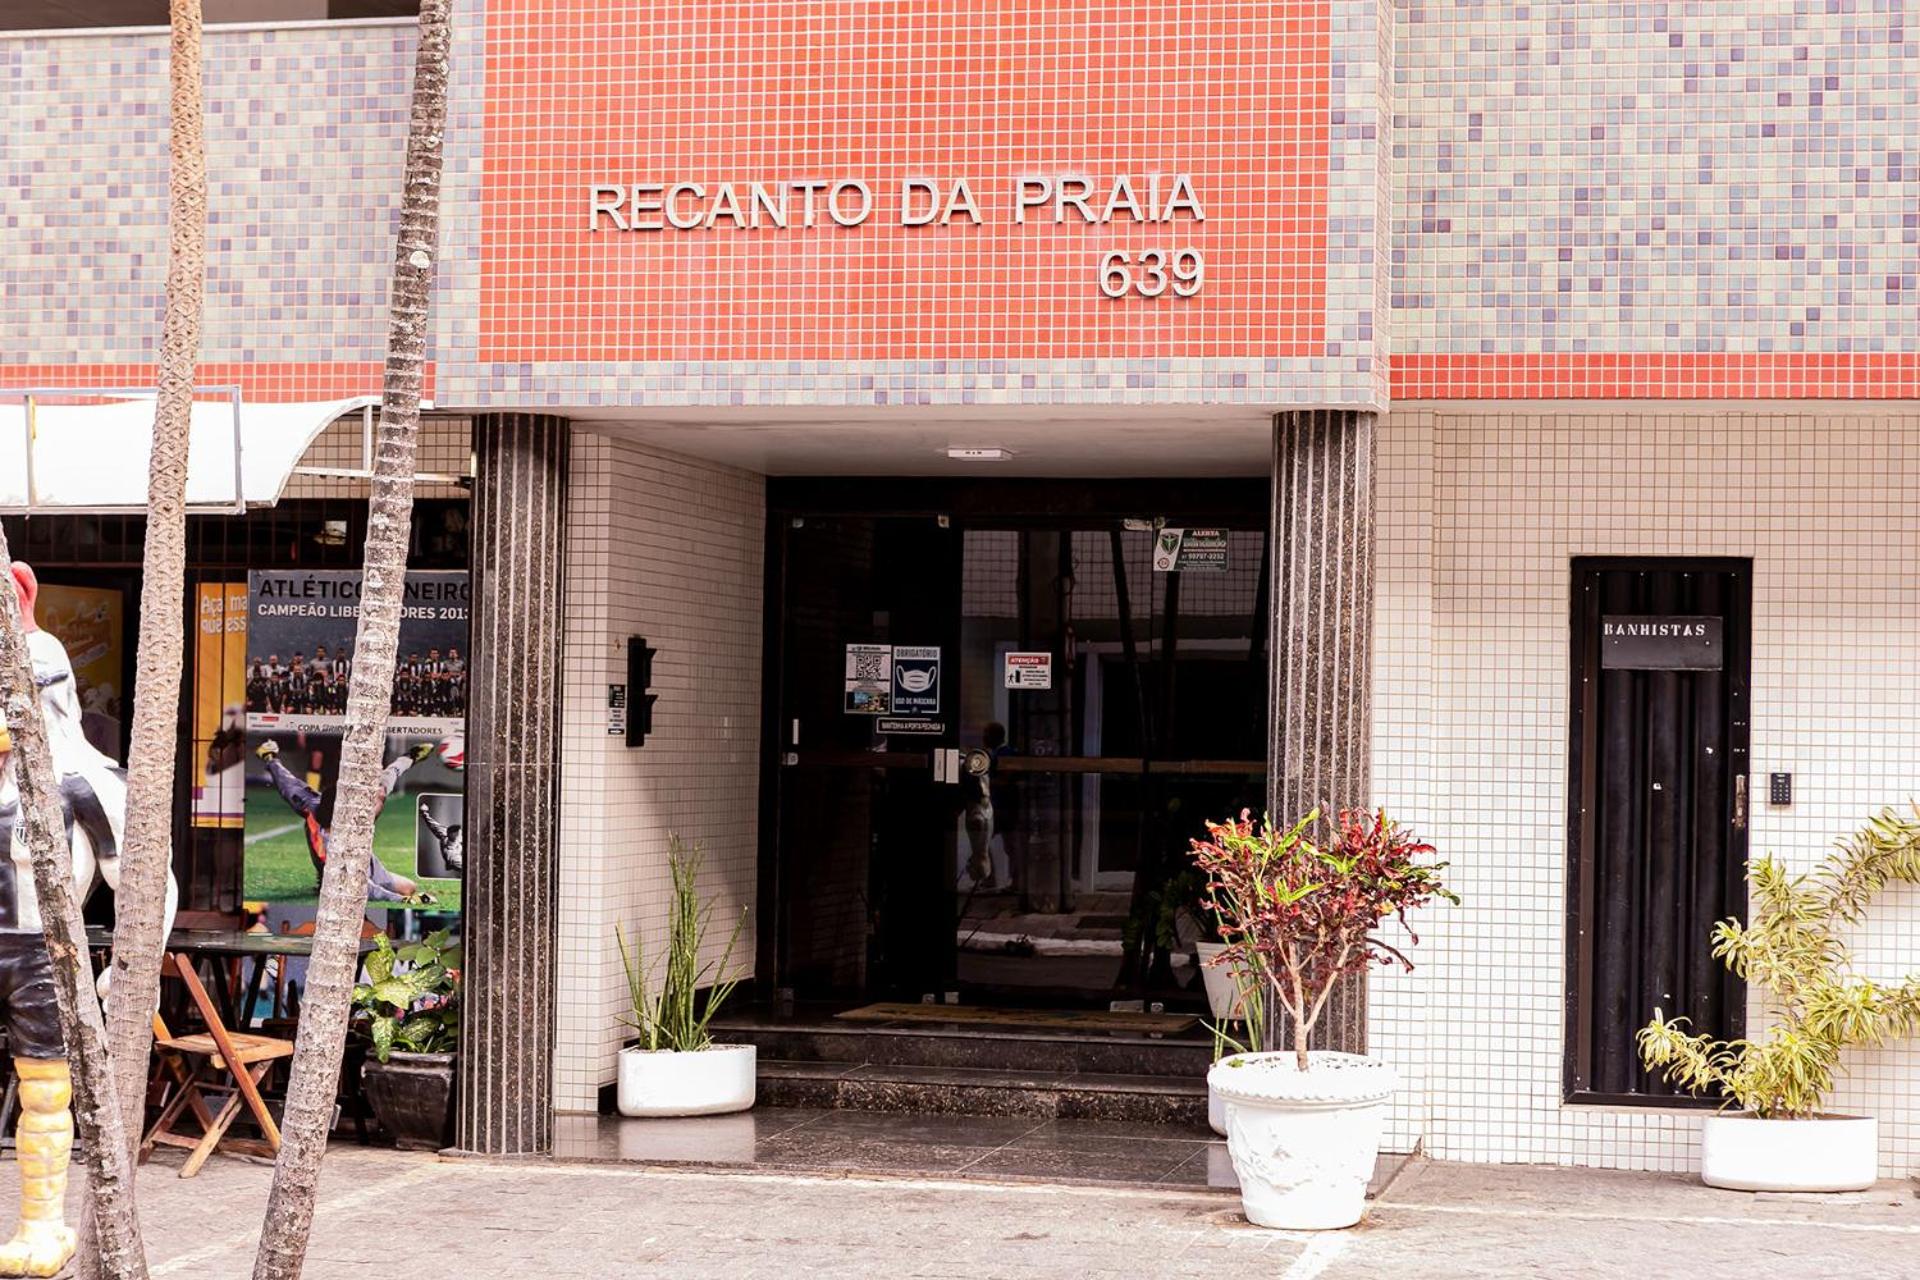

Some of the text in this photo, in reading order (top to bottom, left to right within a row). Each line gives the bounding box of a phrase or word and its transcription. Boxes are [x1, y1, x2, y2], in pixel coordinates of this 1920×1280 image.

[588, 172, 1206, 232] RECANTO DA PRAIA
[1099, 247, 1205, 299] 639
[257, 602, 326, 617] CAMPEÃO
[329, 605, 436, 619] LIBEORES
[1603, 623, 1705, 636] BANHISTAS
[895, 648, 938, 658] OBRIGATÓRIO
